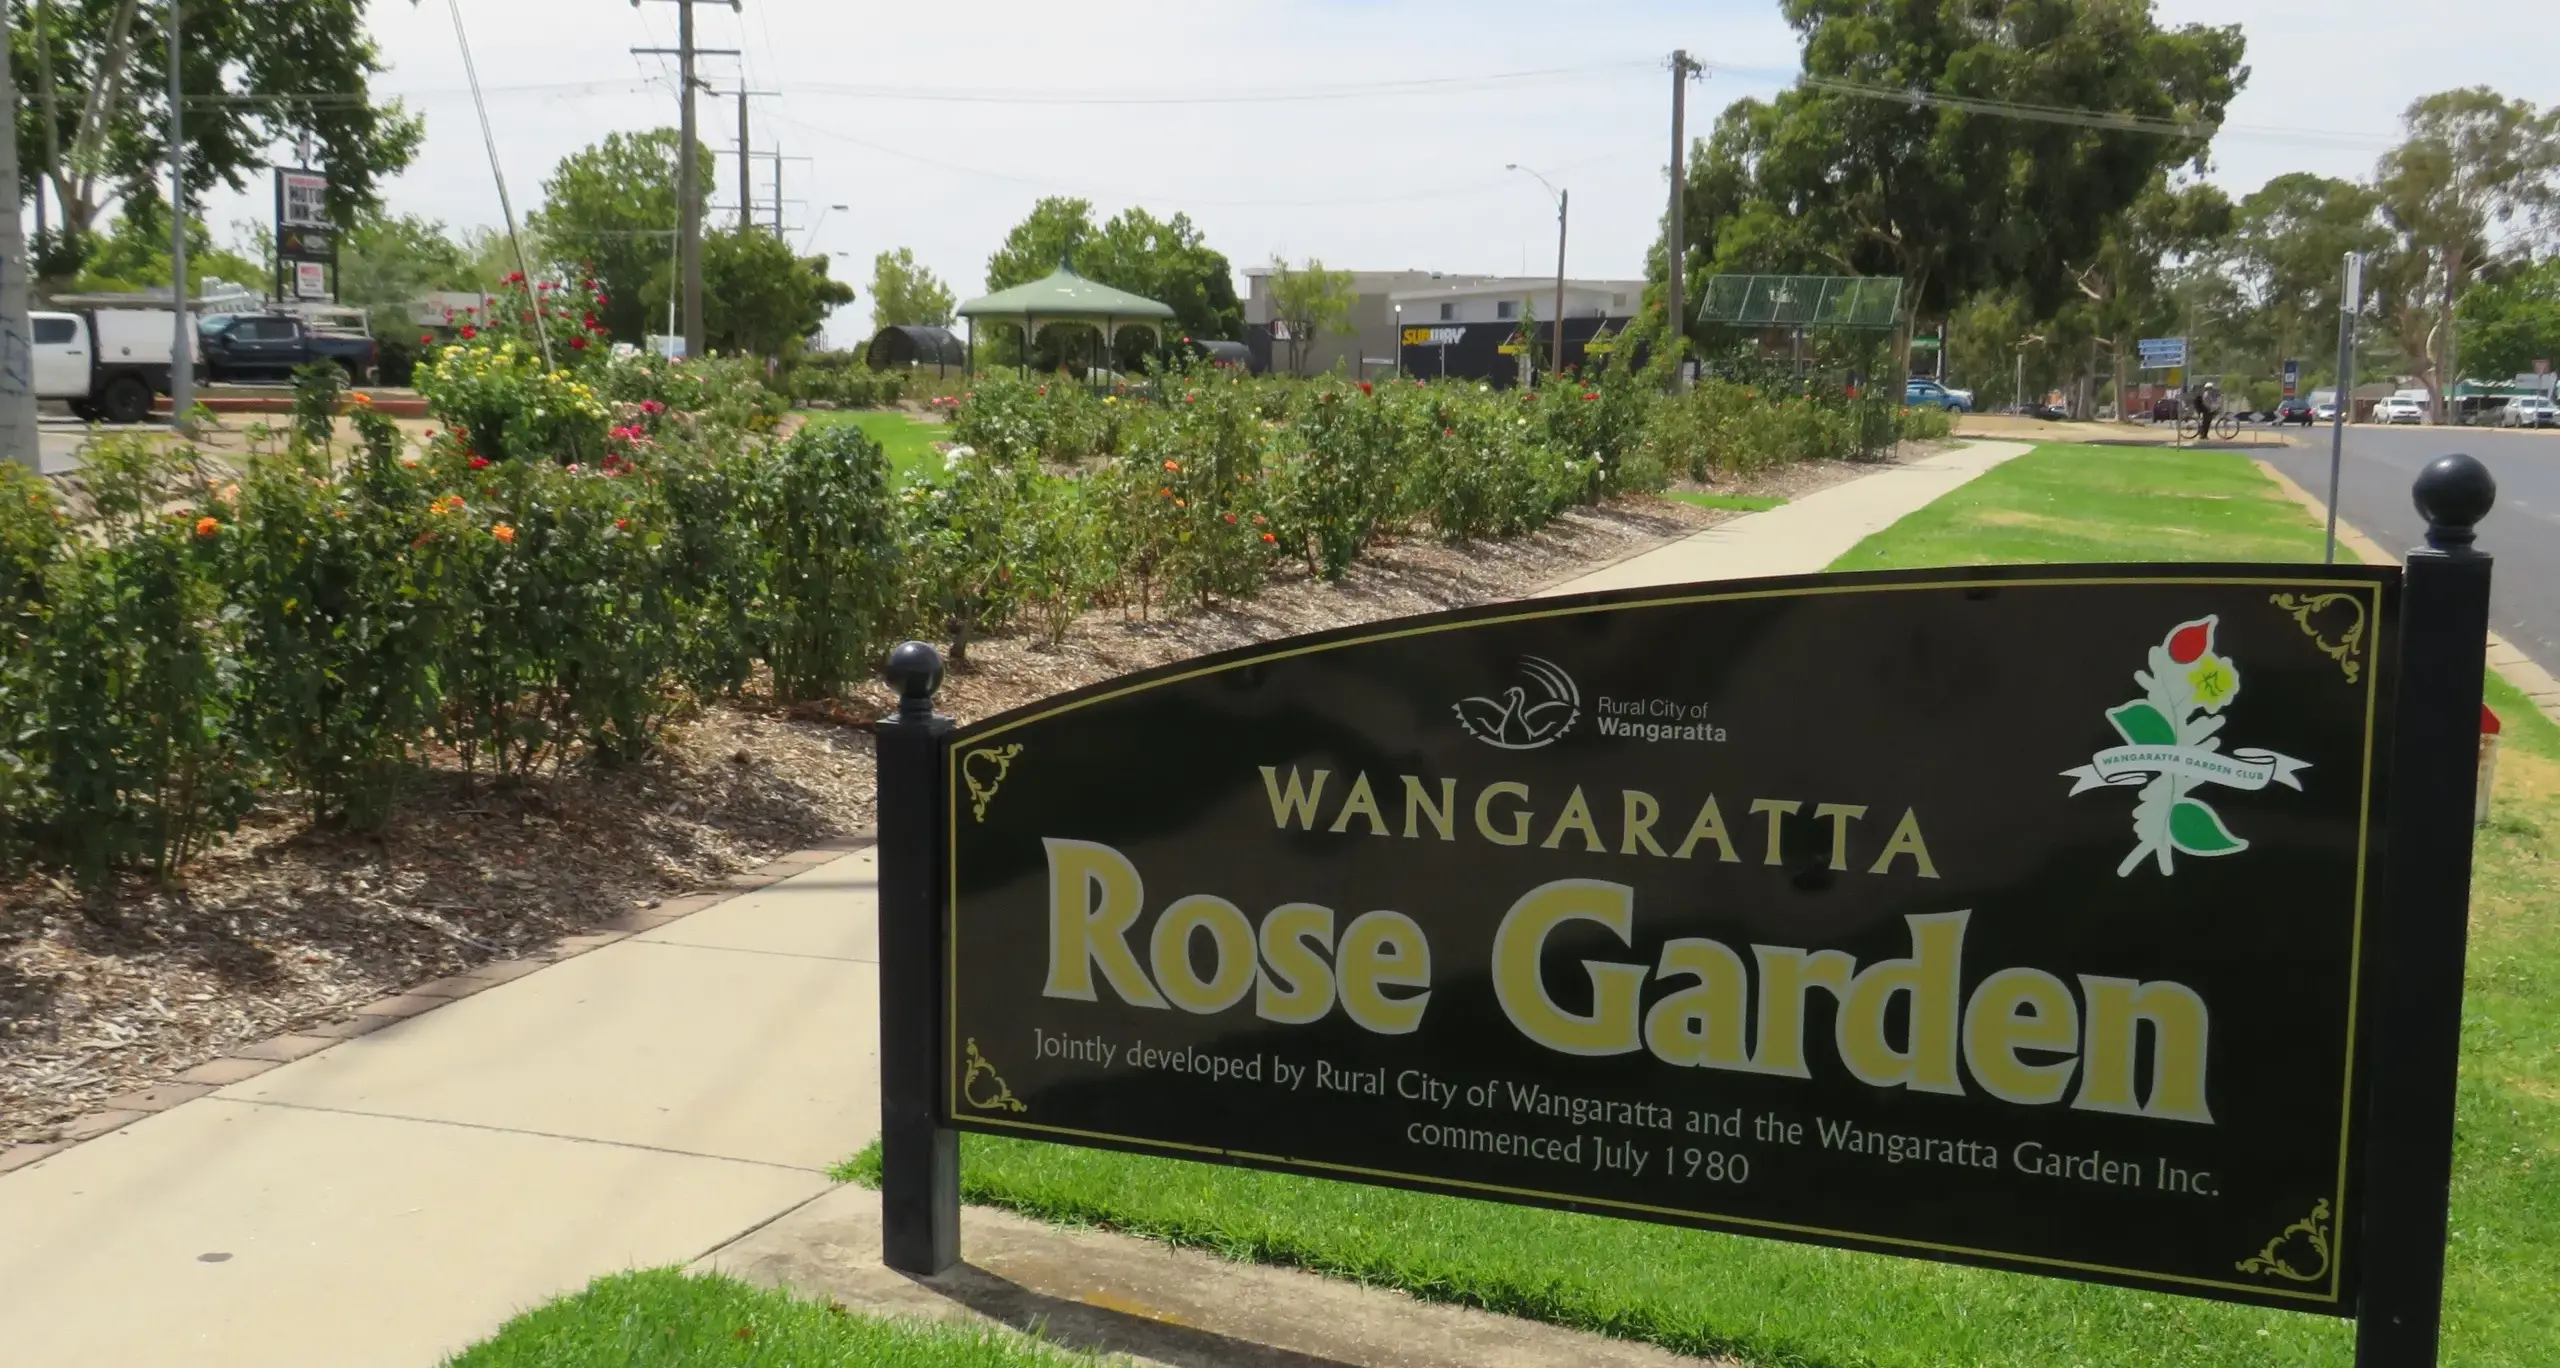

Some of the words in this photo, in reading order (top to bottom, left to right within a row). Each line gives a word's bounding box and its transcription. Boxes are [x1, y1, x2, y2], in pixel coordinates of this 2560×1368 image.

[1402, 327, 1467, 346] SUBWAY
[1597, 716, 1727, 742] Wangaratta
[1599, 697, 1645, 716] Rural
[1650, 699, 1686, 720] City
[1690, 702, 1708, 718] of
[2103, 753, 2180, 766] WANGARATTA
[2185, 757, 2232, 776] GARDEN
[2235, 769, 2264, 781] CLUB
[1259, 764, 1940, 880] WANGARATTA
[1042, 837, 1432, 1036] Rose
[1490, 878, 2215, 1126] Garden
[1034, 1028, 1117, 1068] Jointly
[1126, 1040, 1262, 1081] developed
[1274, 1055, 1306, 1090] by
[1316, 1059, 1385, 1096] Rural
[1397, 1069, 1458, 1109] City
[1466, 1079, 1500, 1108] of
[1506, 1081, 1673, 1129] Wangaratta
[1685, 1108, 1742, 1138] and
[1753, 1111, 1803, 1145] the
[1815, 1116, 1998, 1169] Wangaratta
[2013, 1141, 2141, 1187] Garden
[2157, 1157, 2220, 1197] Inc.
[1407, 1121, 1581, 1164] commenced
[1593, 1135, 1649, 1177] July
[1666, 1145, 1750, 1184] 1980
